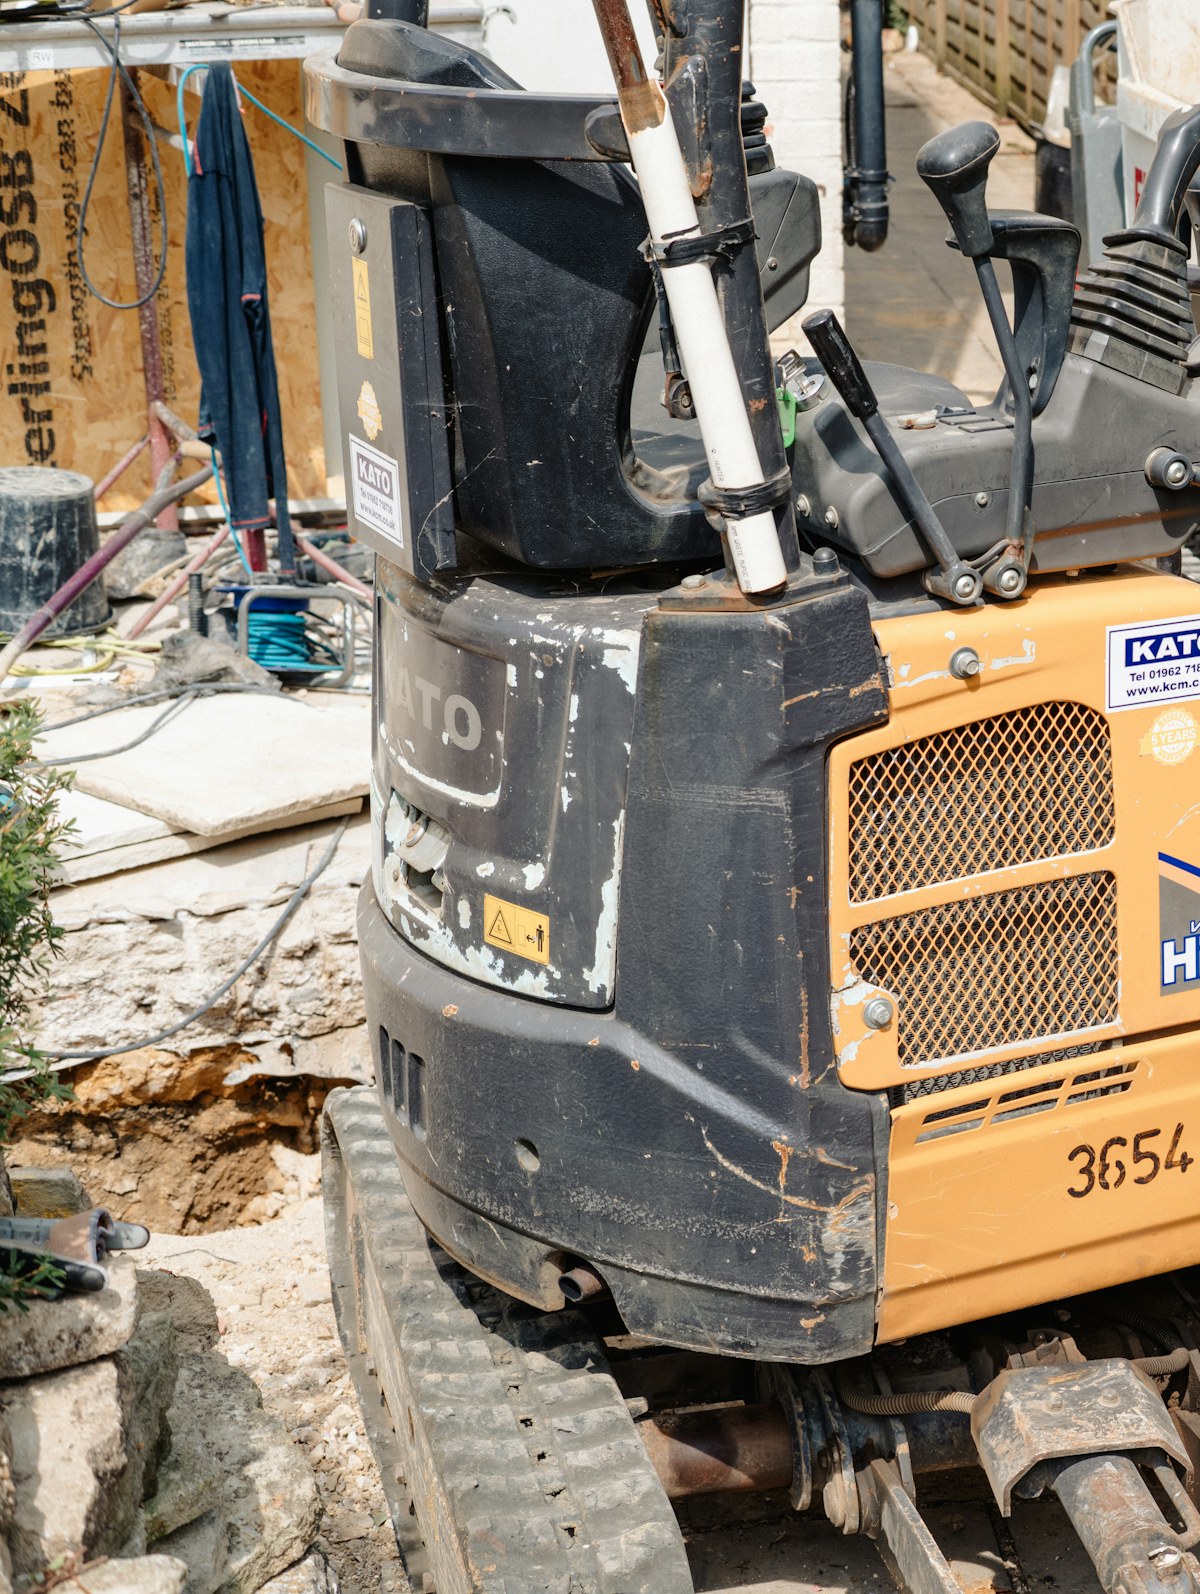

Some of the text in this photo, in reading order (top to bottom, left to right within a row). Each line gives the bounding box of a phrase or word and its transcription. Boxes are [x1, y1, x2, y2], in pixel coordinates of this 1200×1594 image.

[58, 119, 76, 175] can
[62, 182, 89, 239] you
[0, 150, 57, 468] erlingOSB
[358, 457, 391, 495] KATO
[1130, 671, 1146, 682] Tel
[1149, 666, 1181, 680] 01962
[1151, 728, 1197, 746] 5 YEARS
[1067, 1122, 1194, 1198] 3654
